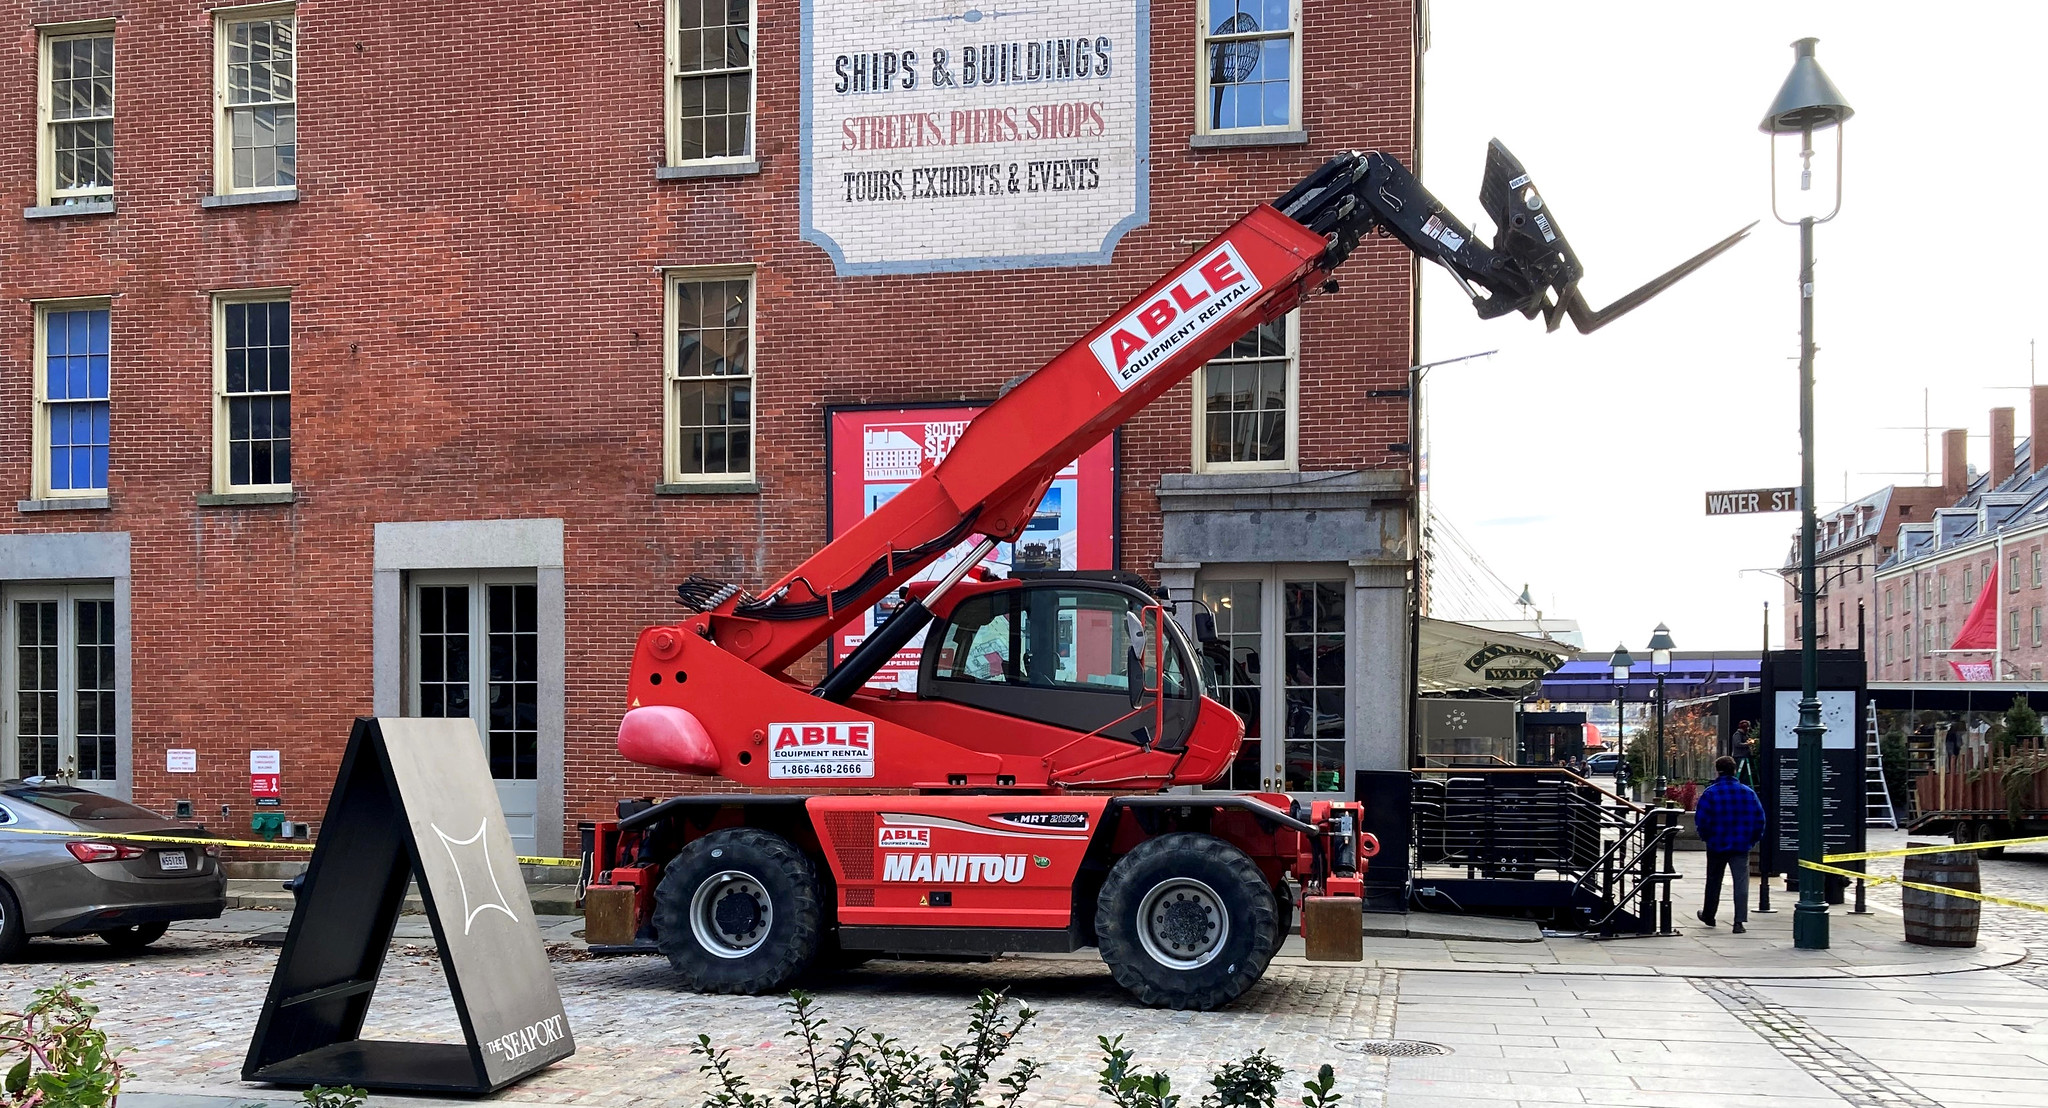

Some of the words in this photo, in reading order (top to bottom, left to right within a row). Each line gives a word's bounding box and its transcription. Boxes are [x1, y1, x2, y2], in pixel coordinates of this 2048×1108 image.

[835, 50, 917, 95] SHIPS
[932, 47, 955, 88] &
[963, 36, 1110, 86] BUILDINGS
[1026, 101, 1105, 141] SHOPS
[1008, 162, 1020, 194] &
[1027, 158, 1099, 193] EVENTS
[1110, 250, 1245, 374] ABLE
[1121, 320, 1196, 381] EQUIPMENT
[1198, 283, 1250, 323] RENTAL
[1708, 493, 1760, 514] WATER
[1771, 491, 1792, 511] ST
[1490, 669, 1539, 679] WALK
[774, 726, 869, 751] ABLE
[775, 750, 829, 758] EQUIPMENT
[781, 764, 862, 775] 1-866-468-2666
[1020, 815, 1049, 823] MRT
[881, 830, 928, 842] ABLE
[883, 853, 1028, 883] MANITOU
[486, 1038, 504, 1055] THE
[501, 1014, 565, 1061] SEAPORT
